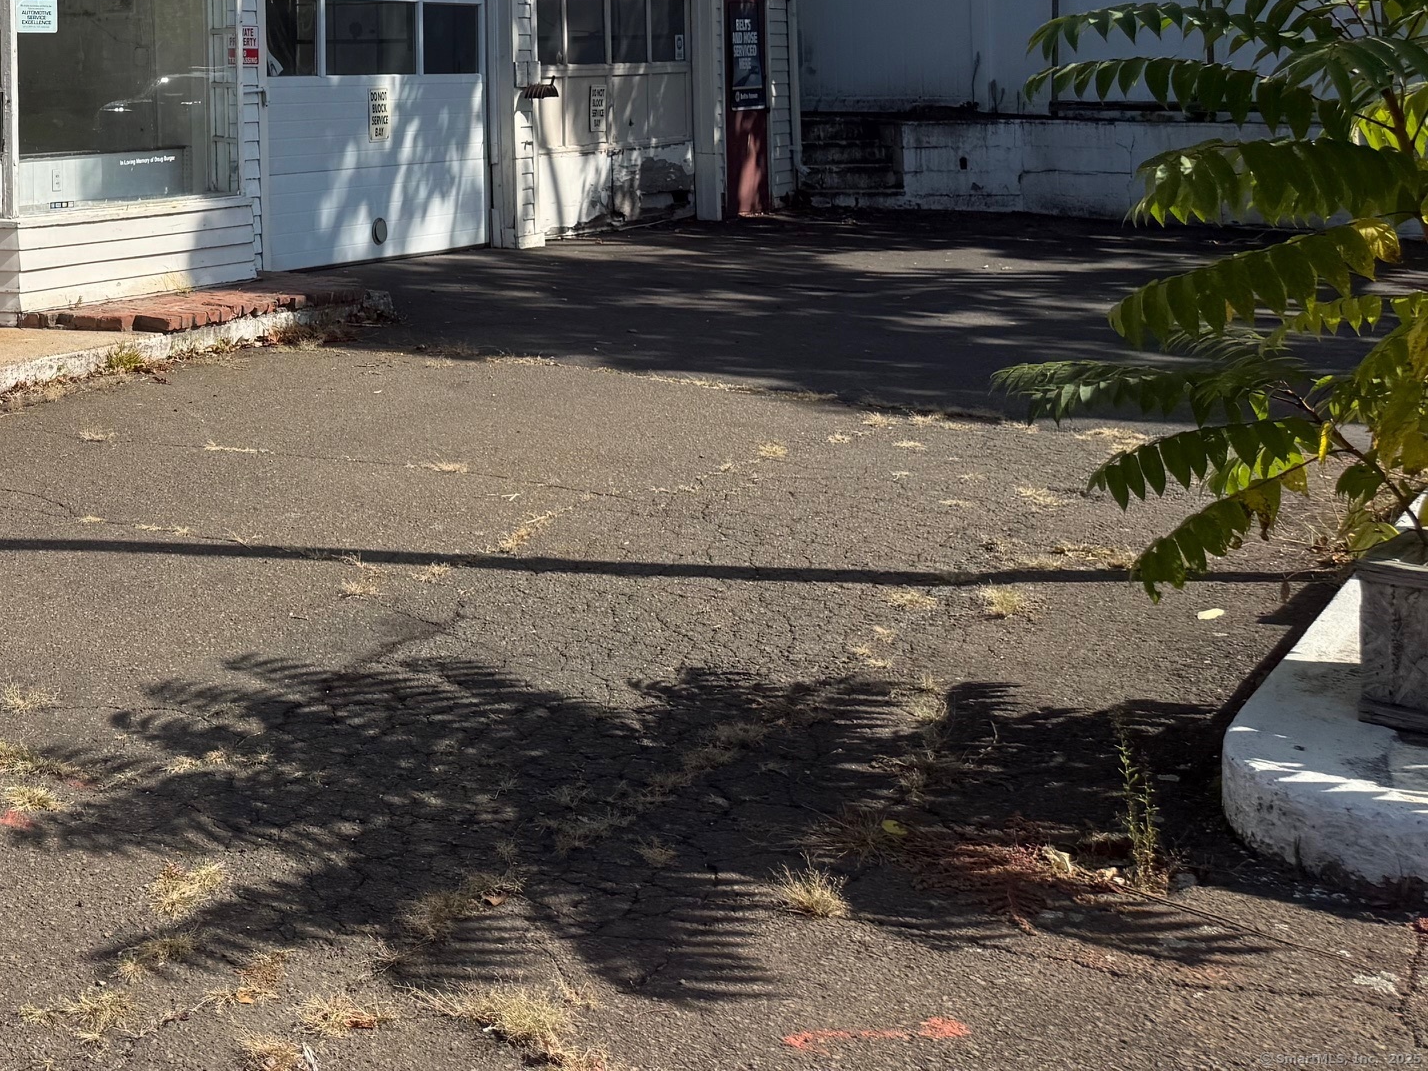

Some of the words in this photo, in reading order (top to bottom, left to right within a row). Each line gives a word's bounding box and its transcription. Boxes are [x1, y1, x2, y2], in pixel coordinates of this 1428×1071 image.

[743, 32, 758, 43] HOSE
[733, 45, 757, 57] SERVICED
[370, 91, 377, 101] DO
[372, 103, 388, 113] BLOCK
[372, 115, 389, 125] SERVICE
